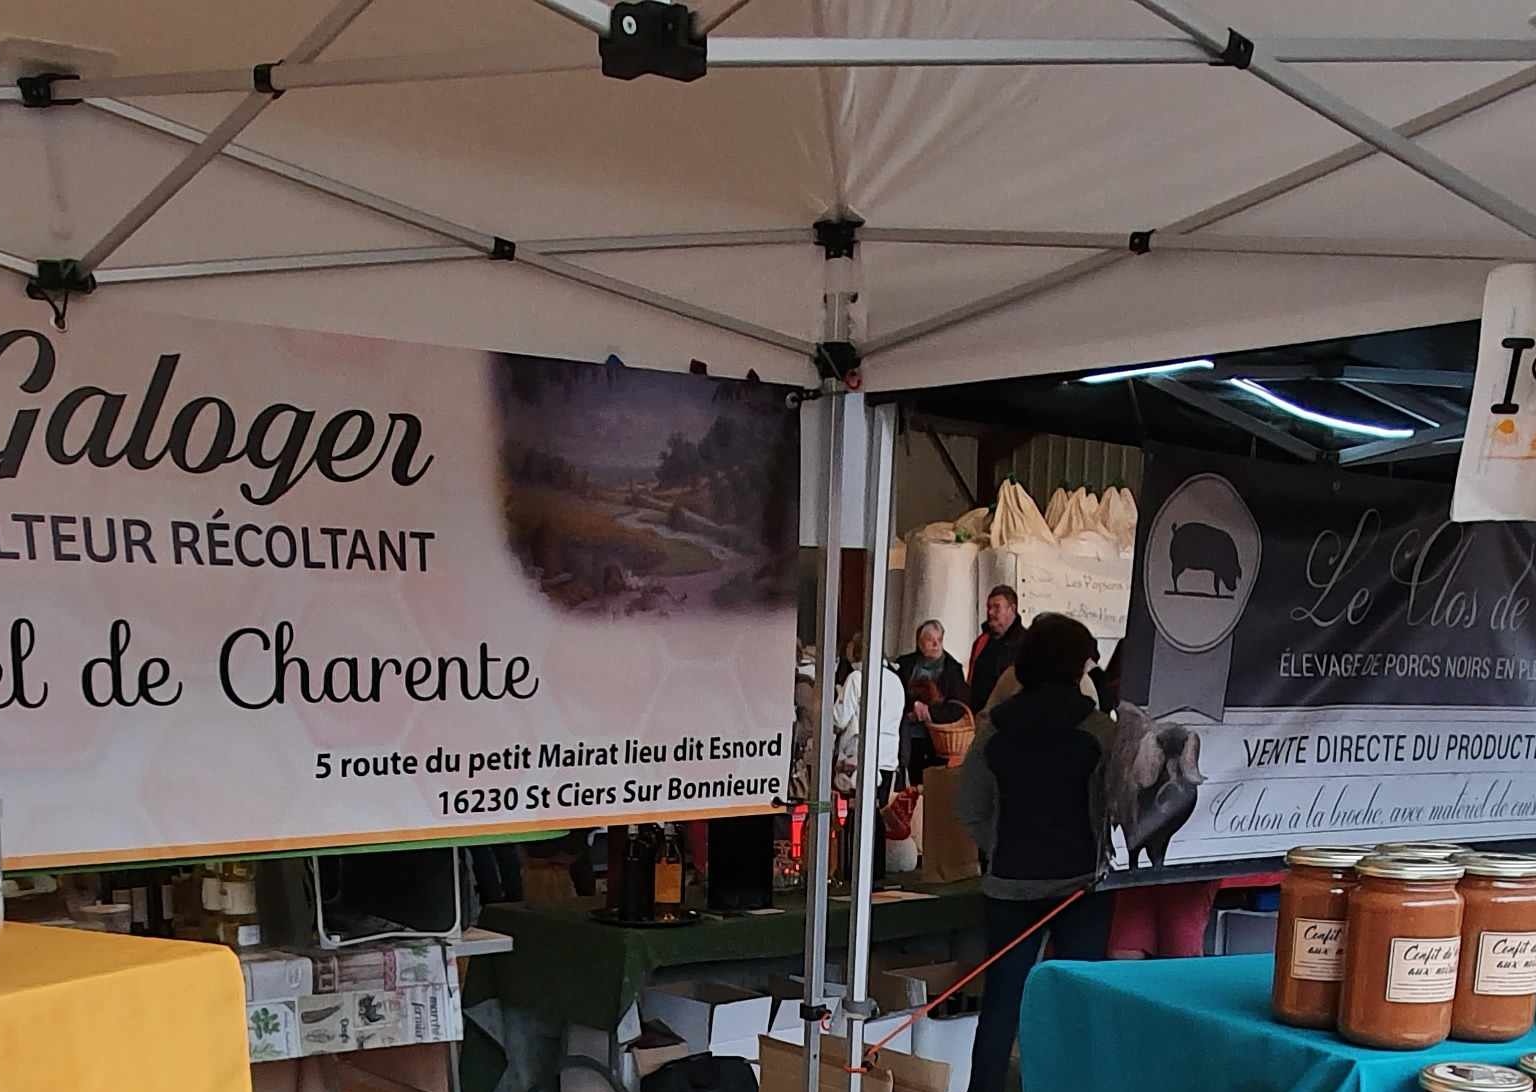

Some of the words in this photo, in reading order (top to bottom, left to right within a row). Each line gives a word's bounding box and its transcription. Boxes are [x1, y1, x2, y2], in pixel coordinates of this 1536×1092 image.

[1491, 338, 1535, 414] I
[172, 506, 435, 572] RÉCOLTANT
[1290, 509, 1382, 627] Le
[1490, 544, 1535, 631] de
[81, 619, 183, 707] de
[219, 626, 540, 712] Charente
[1279, 647, 1362, 677] ÉLEVAGE
[1362, 654, 1381, 675] DE
[1384, 653, 1440, 677] PORCS
[1445, 654, 1491, 679] NOIRS
[1495, 657, 1515, 680] EN
[315, 754, 331, 779] 5
[341, 751, 418, 778] route
[425, 747, 461, 775] du
[468, 744, 531, 778] petit
[538, 742, 618, 768] Mairat
[624, 739, 666, 765] lieu
[673, 737, 704, 762] dit
[709, 733, 782, 761] Esnord
[1243, 735, 1309, 768] VENTE
[1316, 735, 1406, 763] DIRECTE
[1412, 734, 1440, 761] DU
[438, 787, 519, 815] 16230
[526, 785, 550, 810] St
[557, 782, 617, 808] Ciers
[622, 779, 662, 803] Sur
[668, 774, 781, 800] Bonnieure
[1211, 782, 1284, 834] Cochon
[1288, 805, 1301, 830] à
[1305, 784, 1326, 829] la
[1389, 805, 1421, 823] avec
[1491, 779, 1513, 817] de
[1404, 945, 1439, 965] Confit
[1492, 939, 1528, 960] Confit
